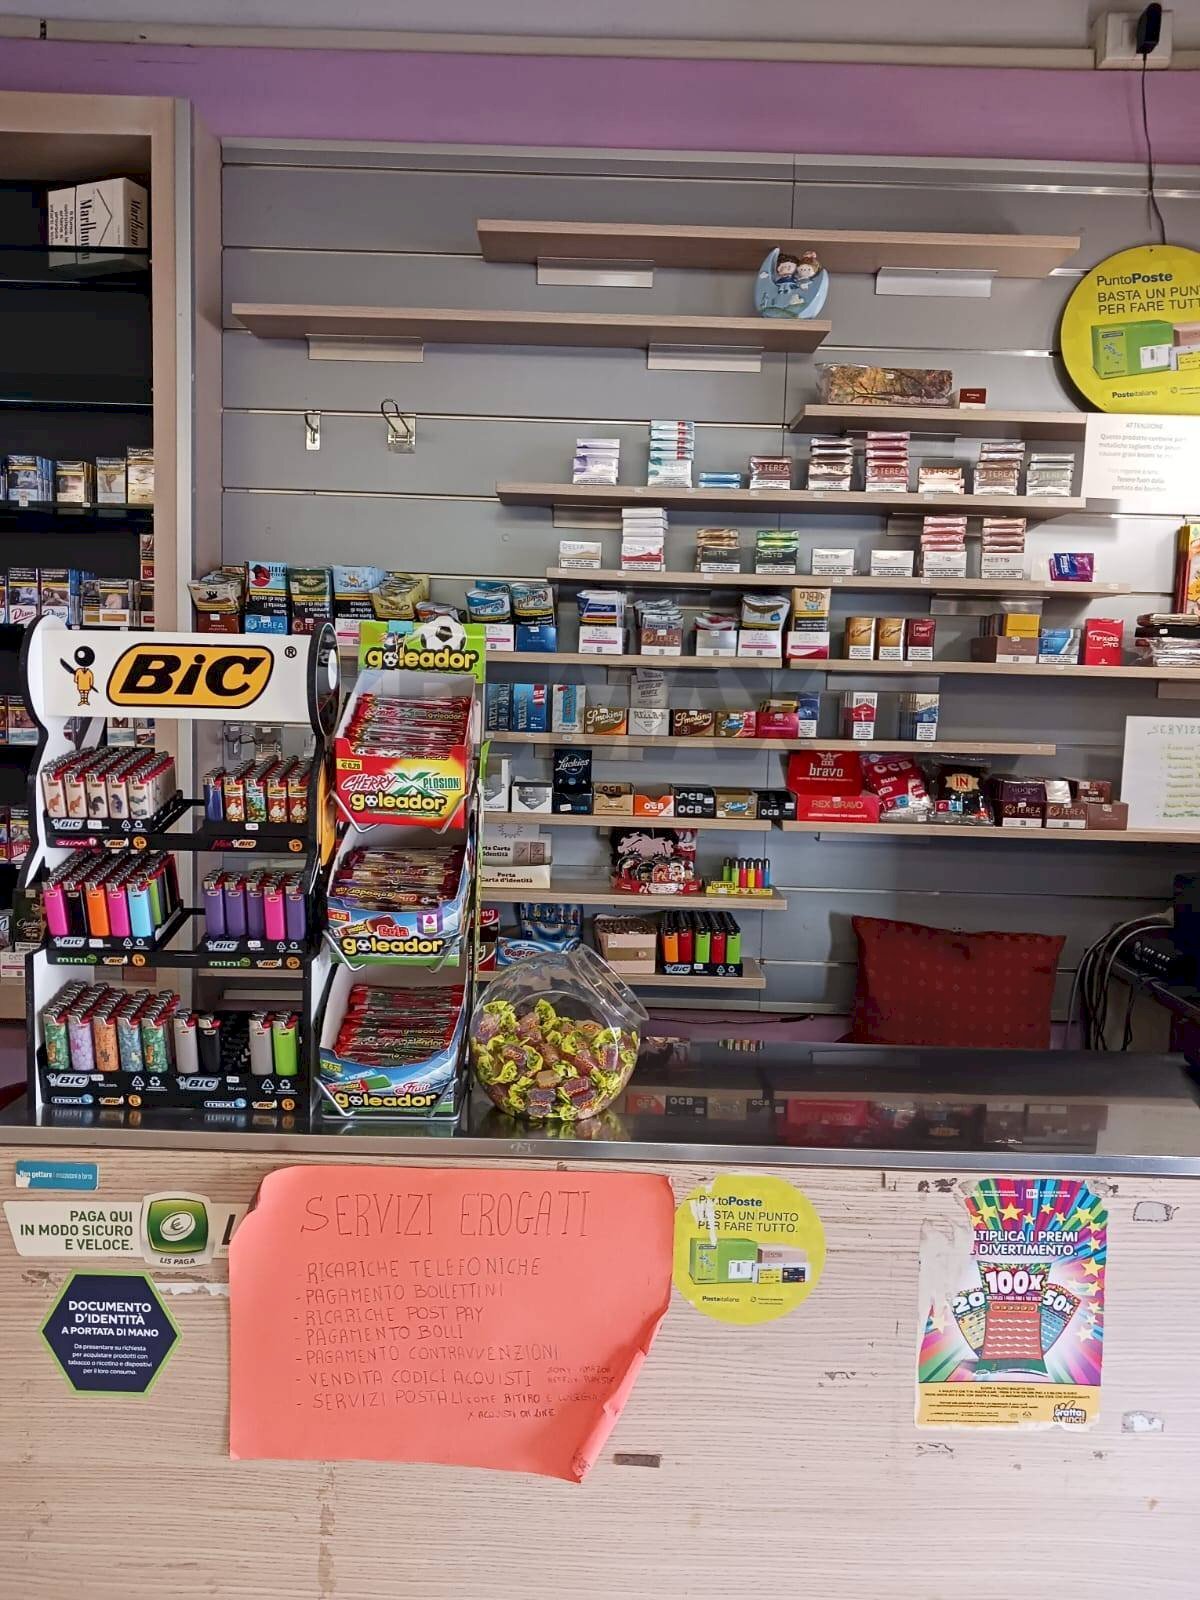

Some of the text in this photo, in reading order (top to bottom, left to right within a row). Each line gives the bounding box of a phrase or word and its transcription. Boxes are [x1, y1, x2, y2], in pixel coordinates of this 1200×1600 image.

[1096, 272, 1173, 287] PuntoPoste
[1097, 290, 1142, 303] BASTA
[1145, 288, 1166, 299] UN
[1098, 303, 1126, 316] PER
[1130, 301, 1165, 313] FARE
[763, 464, 790, 472] TEREA
[880, 467, 906, 475] TEREA
[586, 708, 624, 725] Smoking
[675, 709, 712, 727] Smoking
[808, 762, 844, 777] bravo
[873, 760, 913, 774] OCB
[340, 774, 396, 790] CHERRY
[954, 775, 969, 787] IN
[602, 785, 621, 793] OCB
[644, 801, 665, 811] OCB
[677, 805, 703, 815] OCB
[811, 800, 864, 810] REX BRAVO
[1015, 805, 1041, 815] TEREA
[760, 807, 780, 817] OCB
[500, 876, 533, 884] d'identità
[713, 882, 734, 890] CLIPPER
[341, 936, 445, 955] goleador
[56, 956, 87, 964] mini
[209, 958, 241, 967] mini
[334, 1092, 437, 1109] goleador
[70, 1210, 133, 1223] PAGA QUI
[300, 1190, 591, 1237] SERVIZI EROGATI
[738, 1210, 799, 1222] UN PUNTO
[20, 1224, 133, 1236] IN MODO SICURO
[724, 1222, 753, 1232] FARE
[756, 1223, 799, 1233] TUTTO.
[974, 1230, 1078, 1243] LTIPLICA I PREMI
[65, 1239, 133, 1251] E VELOCE.
[979, 1244, 1078, 1256] DIVERTIMENTO.
[159, 1256, 196, 1265] LIS PAGA
[306, 1256, 541, 1284] RICARICHE TELEFONICHE
[305, 1282, 504, 1305] PAGAMENTO BOLLETTINI
[68, 1300, 152, 1313] DOCUMENTO
[75, 1312, 146, 1326] D'IDENTITÀ
[305, 1305, 485, 1326] RICARICHE POST PAY
[61, 1326, 159, 1337] A PORTATA DI MANO
[306, 1324, 464, 1346] PAGAMENTO BOLLI
[82, 1344, 114, 1352] presentare
[82, 1352, 112, 1360] acquistare
[112, 1352, 137, 1360] prodotti
[306, 1344, 559, 1366] PAGAMENTO CONTRAVVENZIONI
[124, 1360, 153, 1368] dispositivi
[308, 1369, 383, 1387] VENDITA
[391, 1368, 448, 1384] CODICI
[453, 1370, 535, 1388] ACQUISTI
[312, 1391, 386, 1411] SERVIZI
[394, 1391, 463, 1405] POSTALI
[503, 1393, 541, 1405] RITIRO
